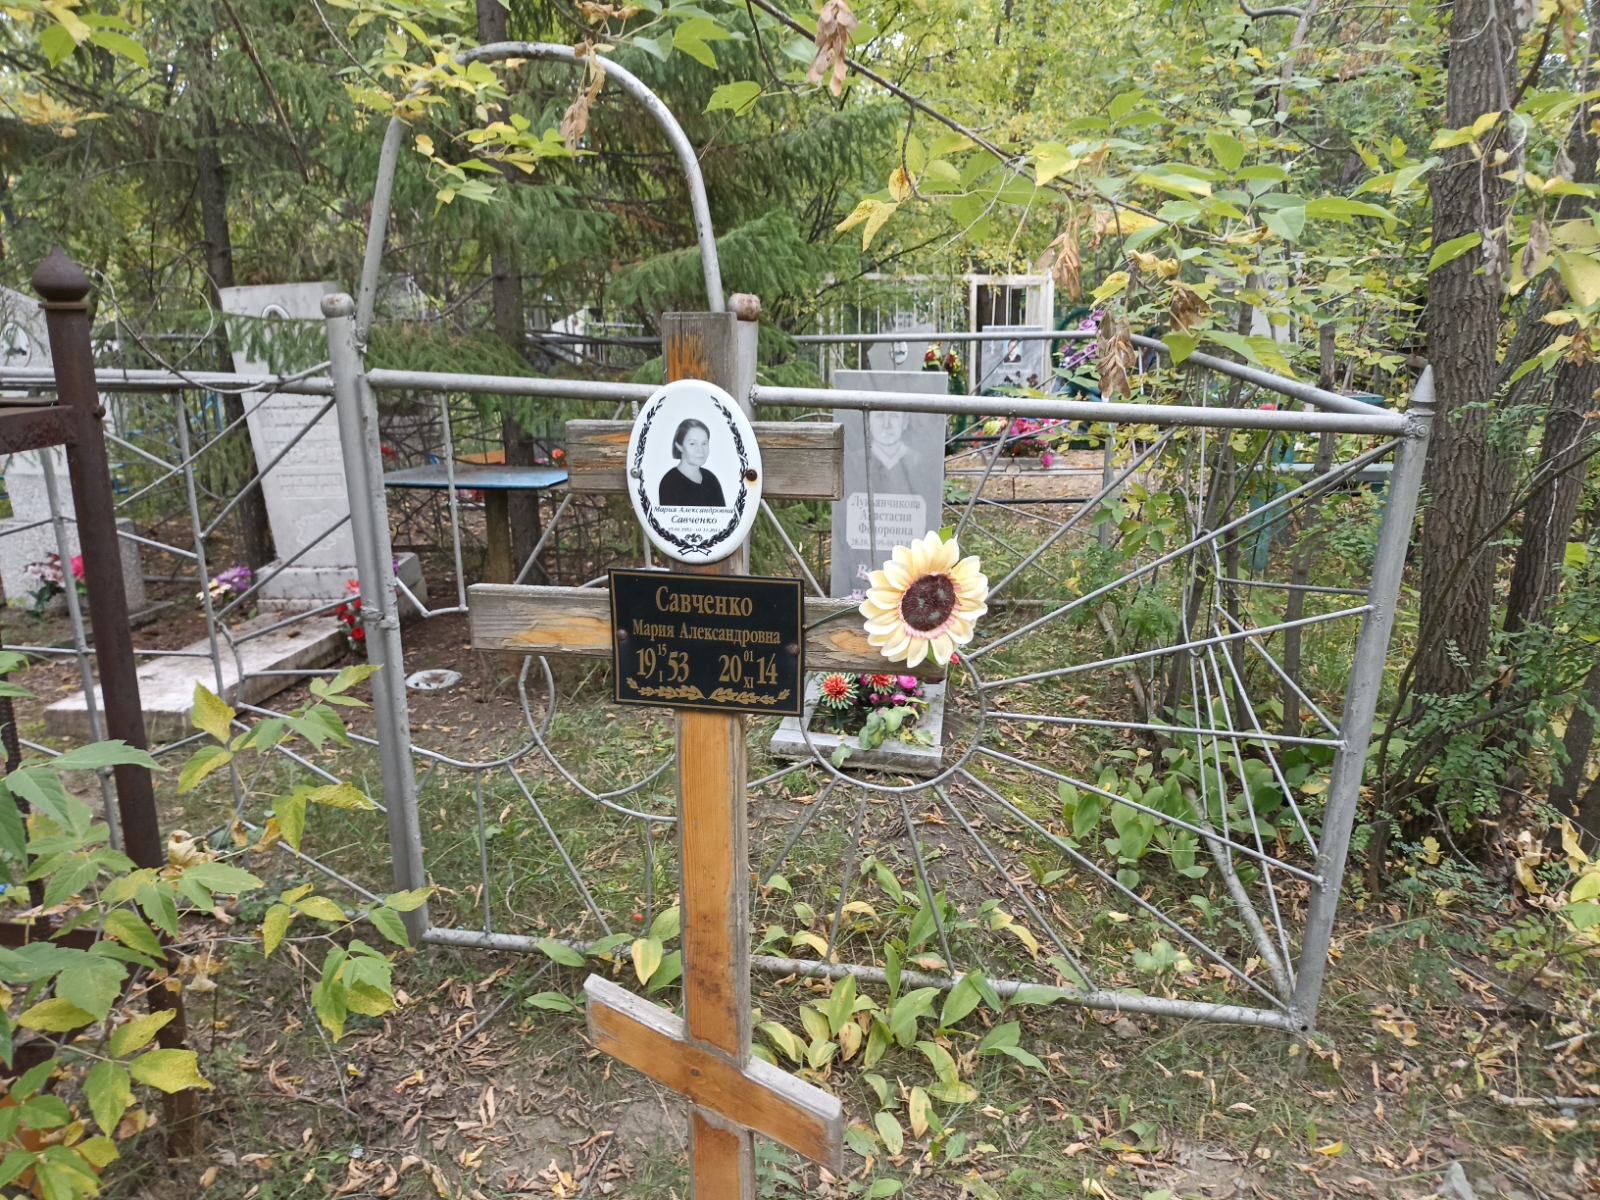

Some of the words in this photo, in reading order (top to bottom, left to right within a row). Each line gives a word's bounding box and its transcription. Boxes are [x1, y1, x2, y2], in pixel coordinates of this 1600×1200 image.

[852, 495, 921, 510] Лукянчикова
[653, 506, 677, 514] Мария
[679, 507, 734, 516] Александровна
[860, 509, 912, 522] Аастасия
[671, 515, 717, 524] Савченко
[655, 585, 753, 617] Савченко
[632, 619, 675, 641] Мария
[679, 622, 781, 647] Александровна
